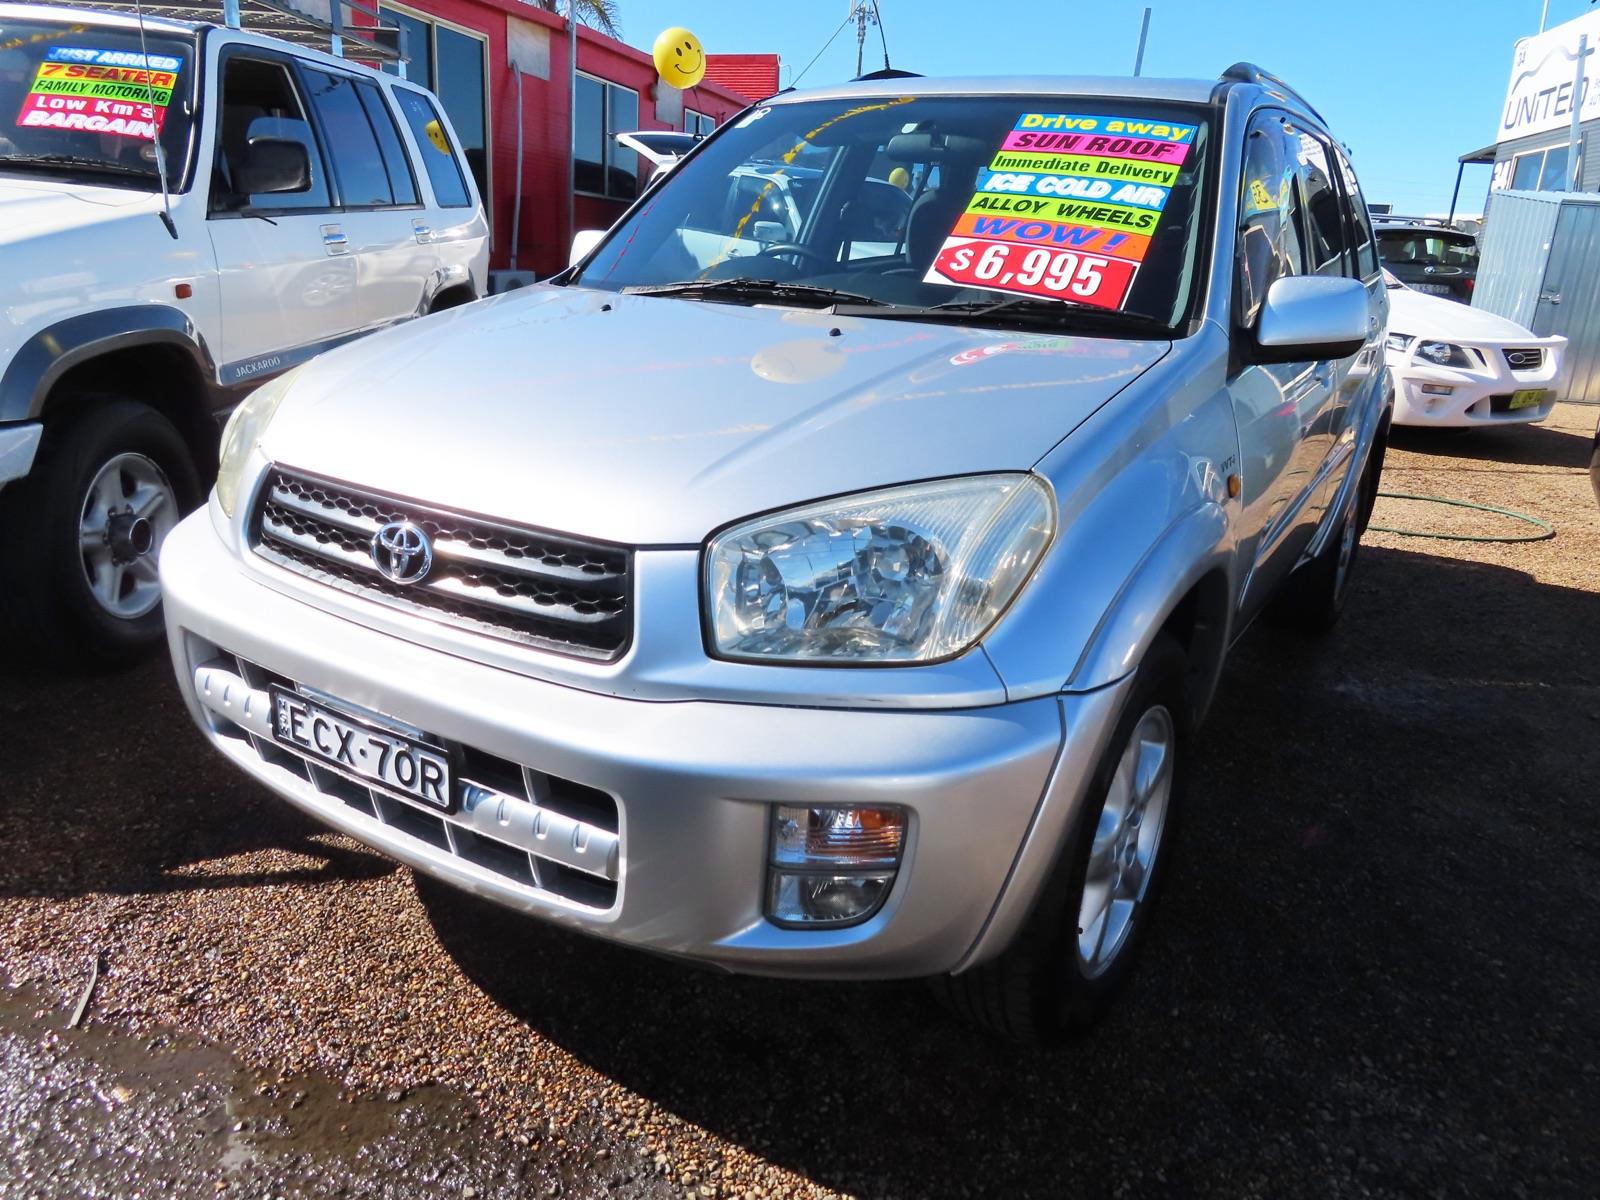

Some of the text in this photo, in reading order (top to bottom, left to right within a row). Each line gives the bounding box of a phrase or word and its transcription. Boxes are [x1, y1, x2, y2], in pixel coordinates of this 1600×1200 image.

[48, 48, 179, 69] JUST ARRIVED
[42, 64, 174, 86] 7 SEATER
[35, 79, 168, 102] FAMILY MOTORING
[95, 101, 156, 119] Km's
[23, 110, 160, 137] BARGAIN
[1021, 113, 1190, 142] Drive away
[1014, 133, 1177, 158] SUN ROOF
[995, 155, 1174, 184] Immediate Delivery
[984, 173, 1166, 208] ICE COLD AIR
[973, 197, 1155, 229] ALLOY WHEELS
[236, 356, 281, 378] JACKAROO
